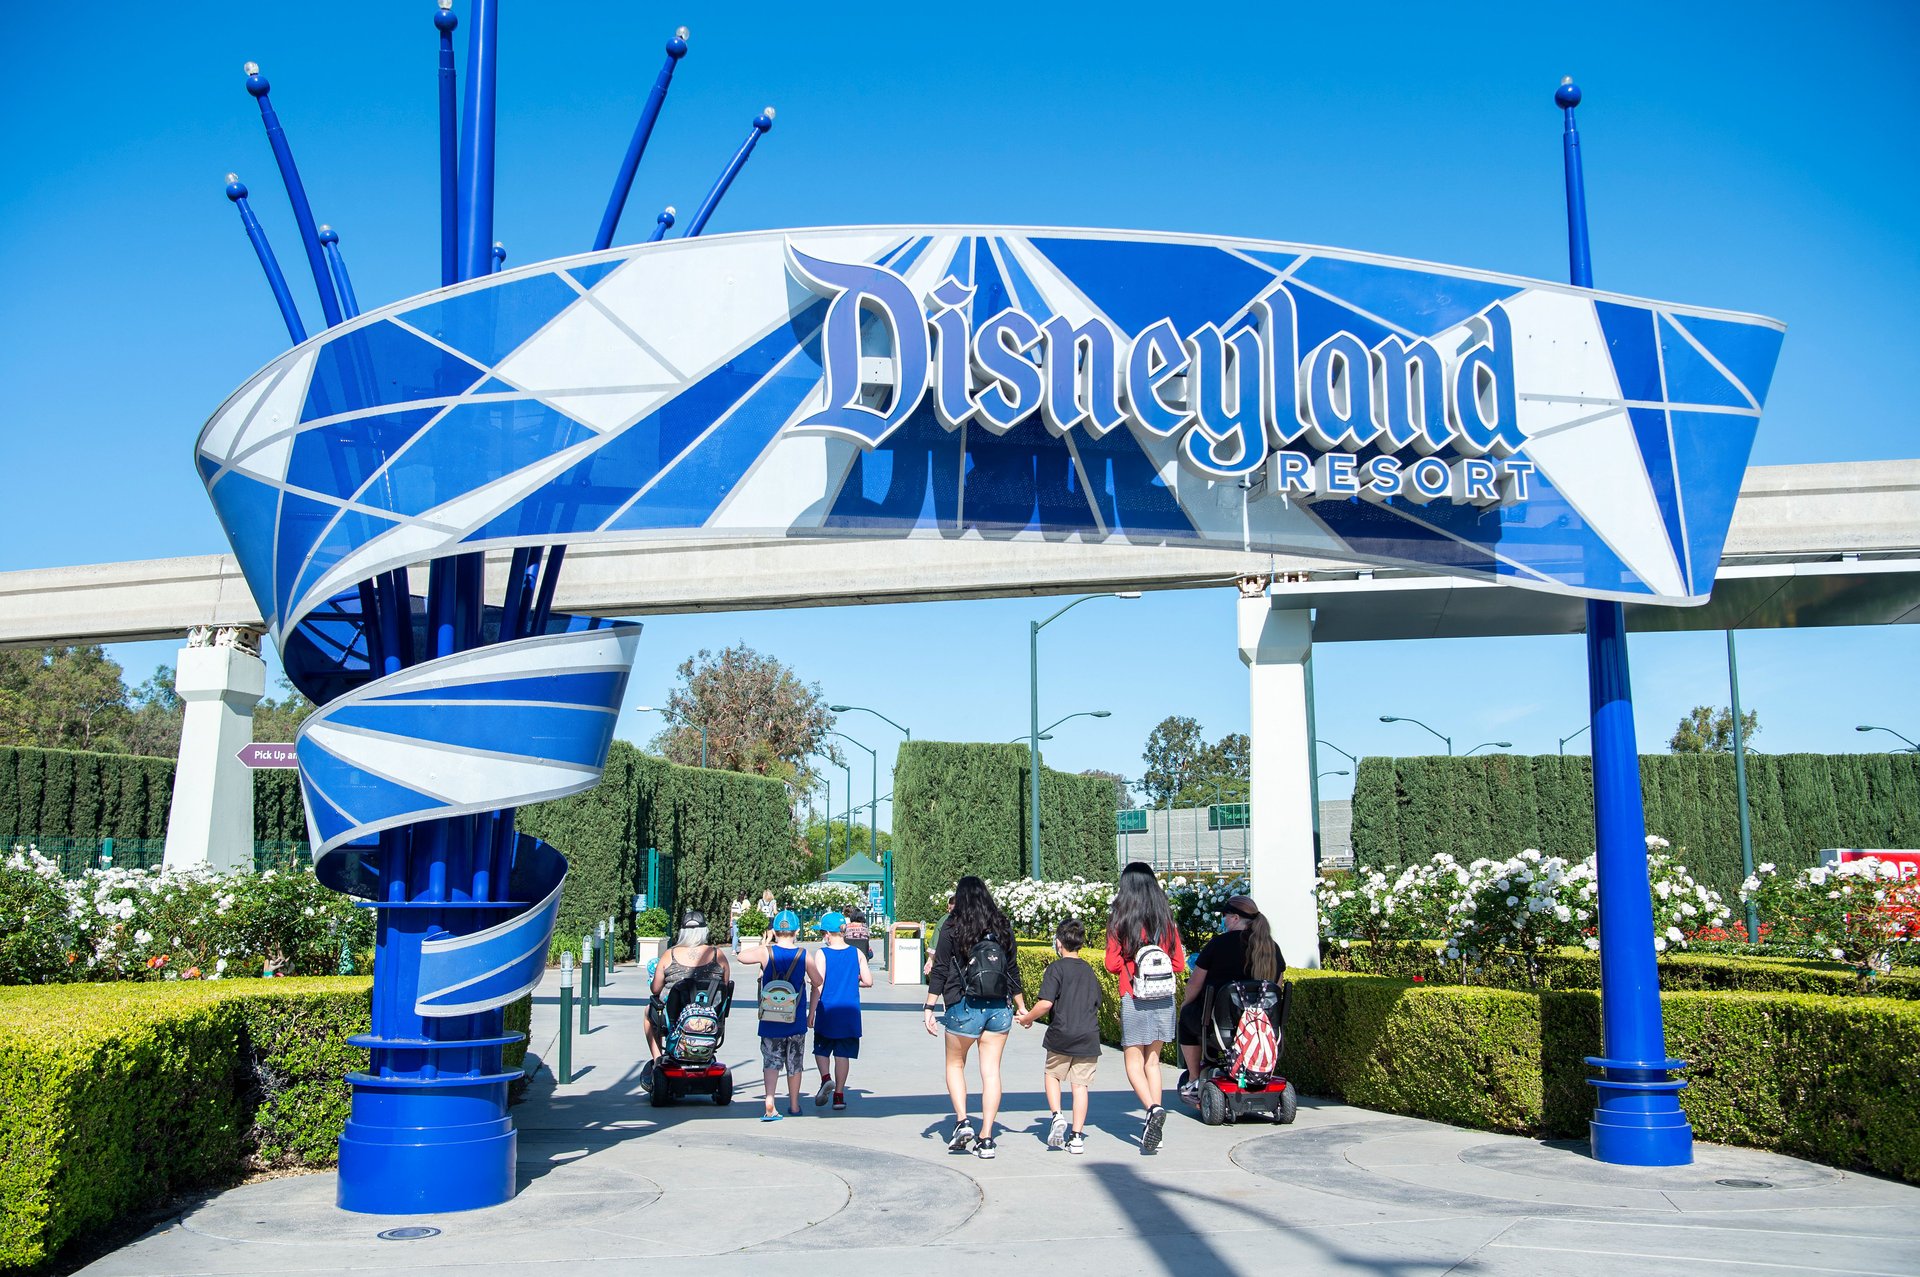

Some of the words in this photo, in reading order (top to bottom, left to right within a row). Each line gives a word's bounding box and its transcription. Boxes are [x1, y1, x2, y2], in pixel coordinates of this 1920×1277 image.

[783, 232, 1532, 477] Disneyland
[1276, 449, 1536, 501] RESORT
[254, 750, 272, 760] Pick
[273, 750, 286, 762] Up
